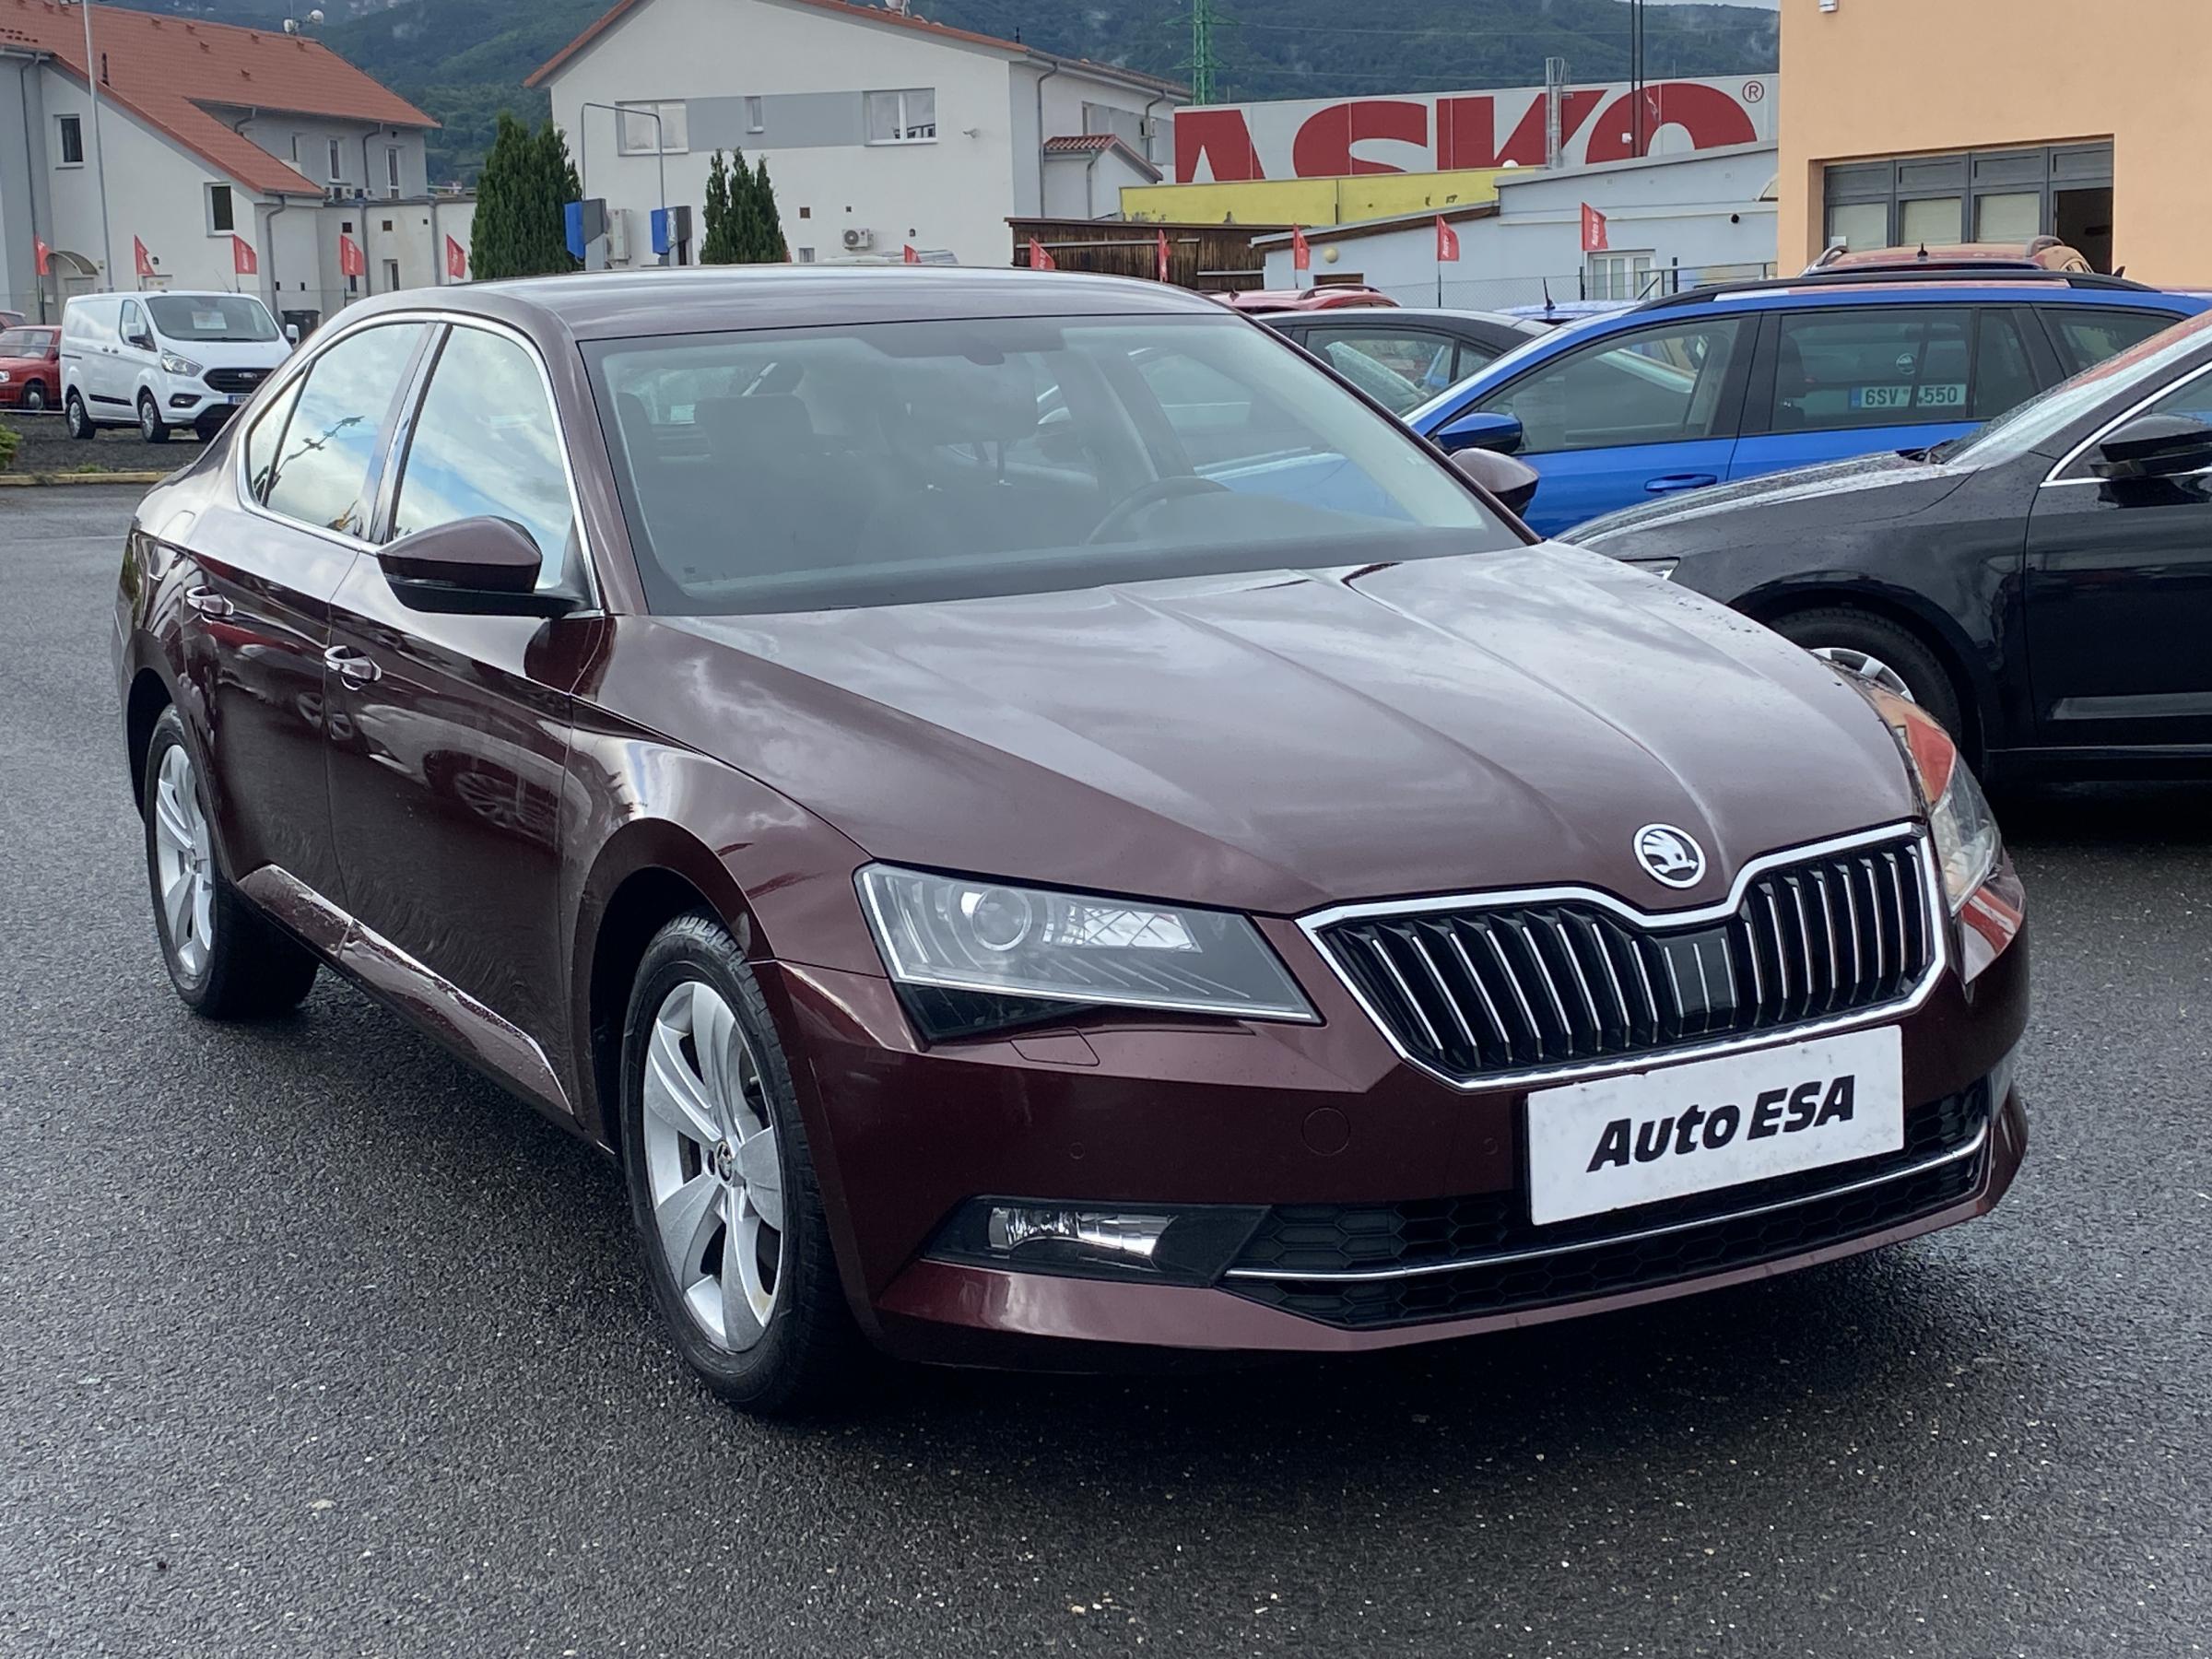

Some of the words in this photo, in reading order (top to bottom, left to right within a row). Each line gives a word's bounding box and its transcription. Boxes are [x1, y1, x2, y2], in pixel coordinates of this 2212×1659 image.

[1865, 388, 1899, 406] 6SV
[1586, 1104, 1741, 1173] Auto
[1747, 1074, 1855, 1141] ESA
